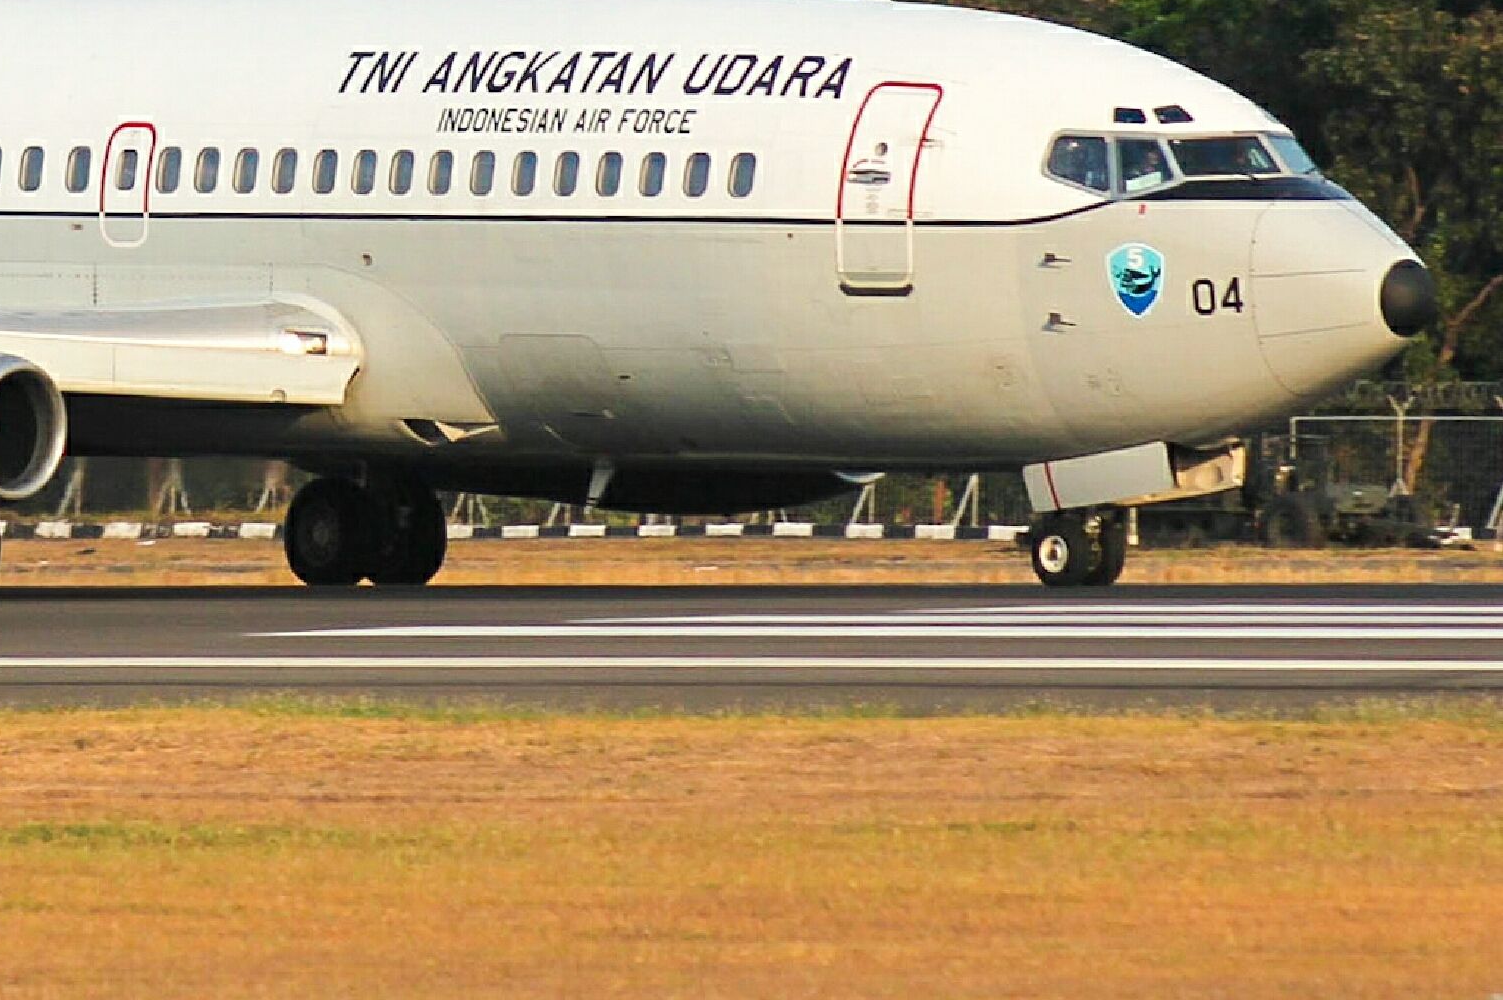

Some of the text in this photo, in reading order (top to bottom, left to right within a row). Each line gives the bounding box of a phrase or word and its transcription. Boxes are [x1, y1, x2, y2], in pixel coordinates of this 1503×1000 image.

[338, 51, 853, 99] TNI ANGKATAN UDARA
[436, 108, 698, 134] INDONESIAN AIR FORCE
[1127, 248, 1145, 267] 5
[1192, 276, 1244, 316] 04
